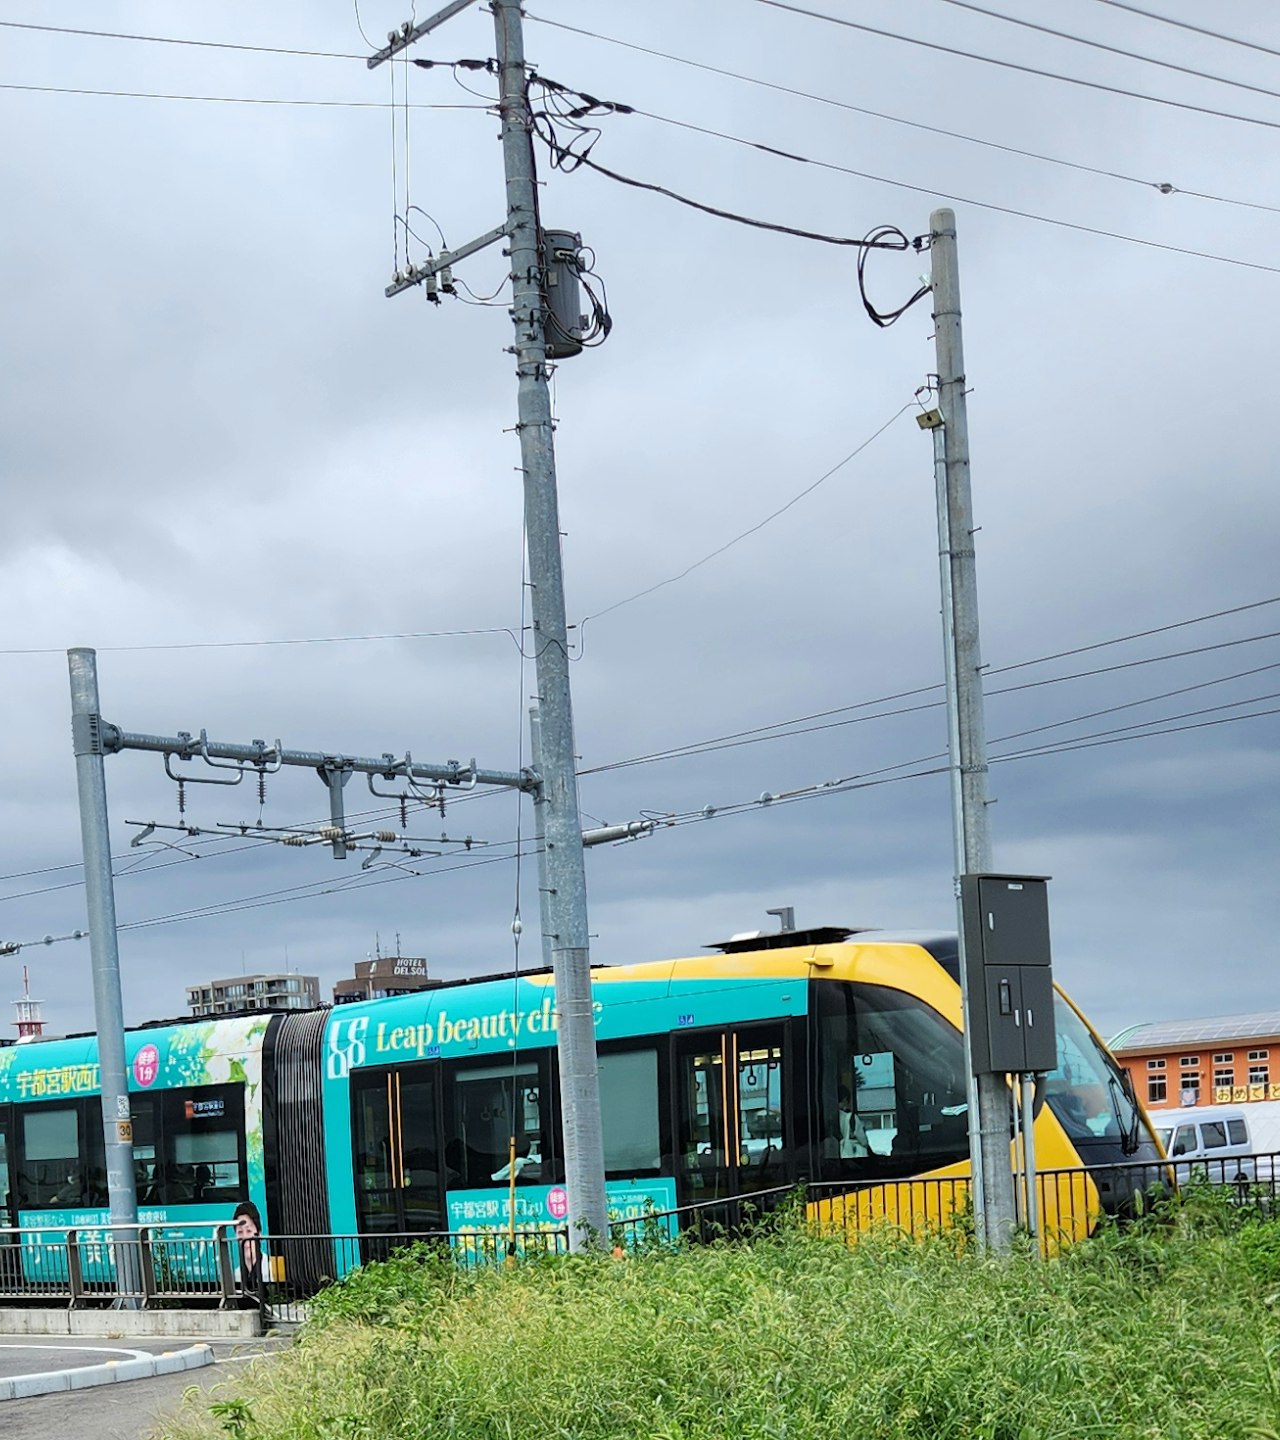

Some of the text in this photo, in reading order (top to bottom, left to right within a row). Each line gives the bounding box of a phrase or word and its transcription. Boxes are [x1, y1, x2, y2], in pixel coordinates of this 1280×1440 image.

[396, 958, 423, 967] HOTEL
[376, 997, 603, 1057] Leap beauty clic
[138, 1066, 154, 1081] 1分
[119, 1125, 131, 1137] 30
[450, 1200, 500, 1220] 宇都宮駅
